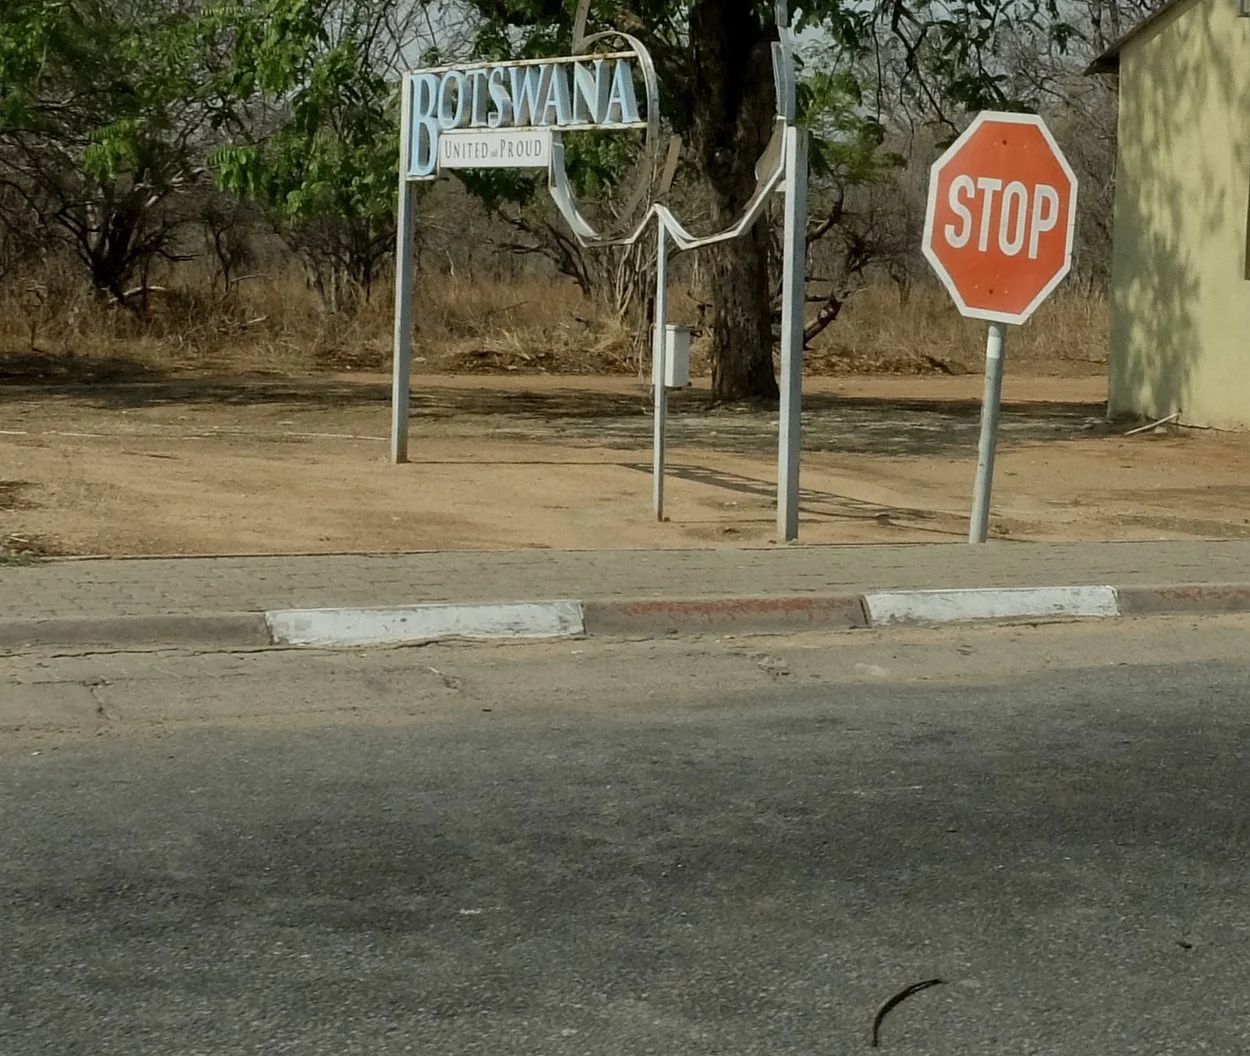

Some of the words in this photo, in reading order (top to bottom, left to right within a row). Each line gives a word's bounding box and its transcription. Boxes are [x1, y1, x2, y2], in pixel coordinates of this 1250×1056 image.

[444, 140, 488, 158] UNITED
[500, 139, 542, 158] PROUD
[944, 174, 1060, 260] STOP
